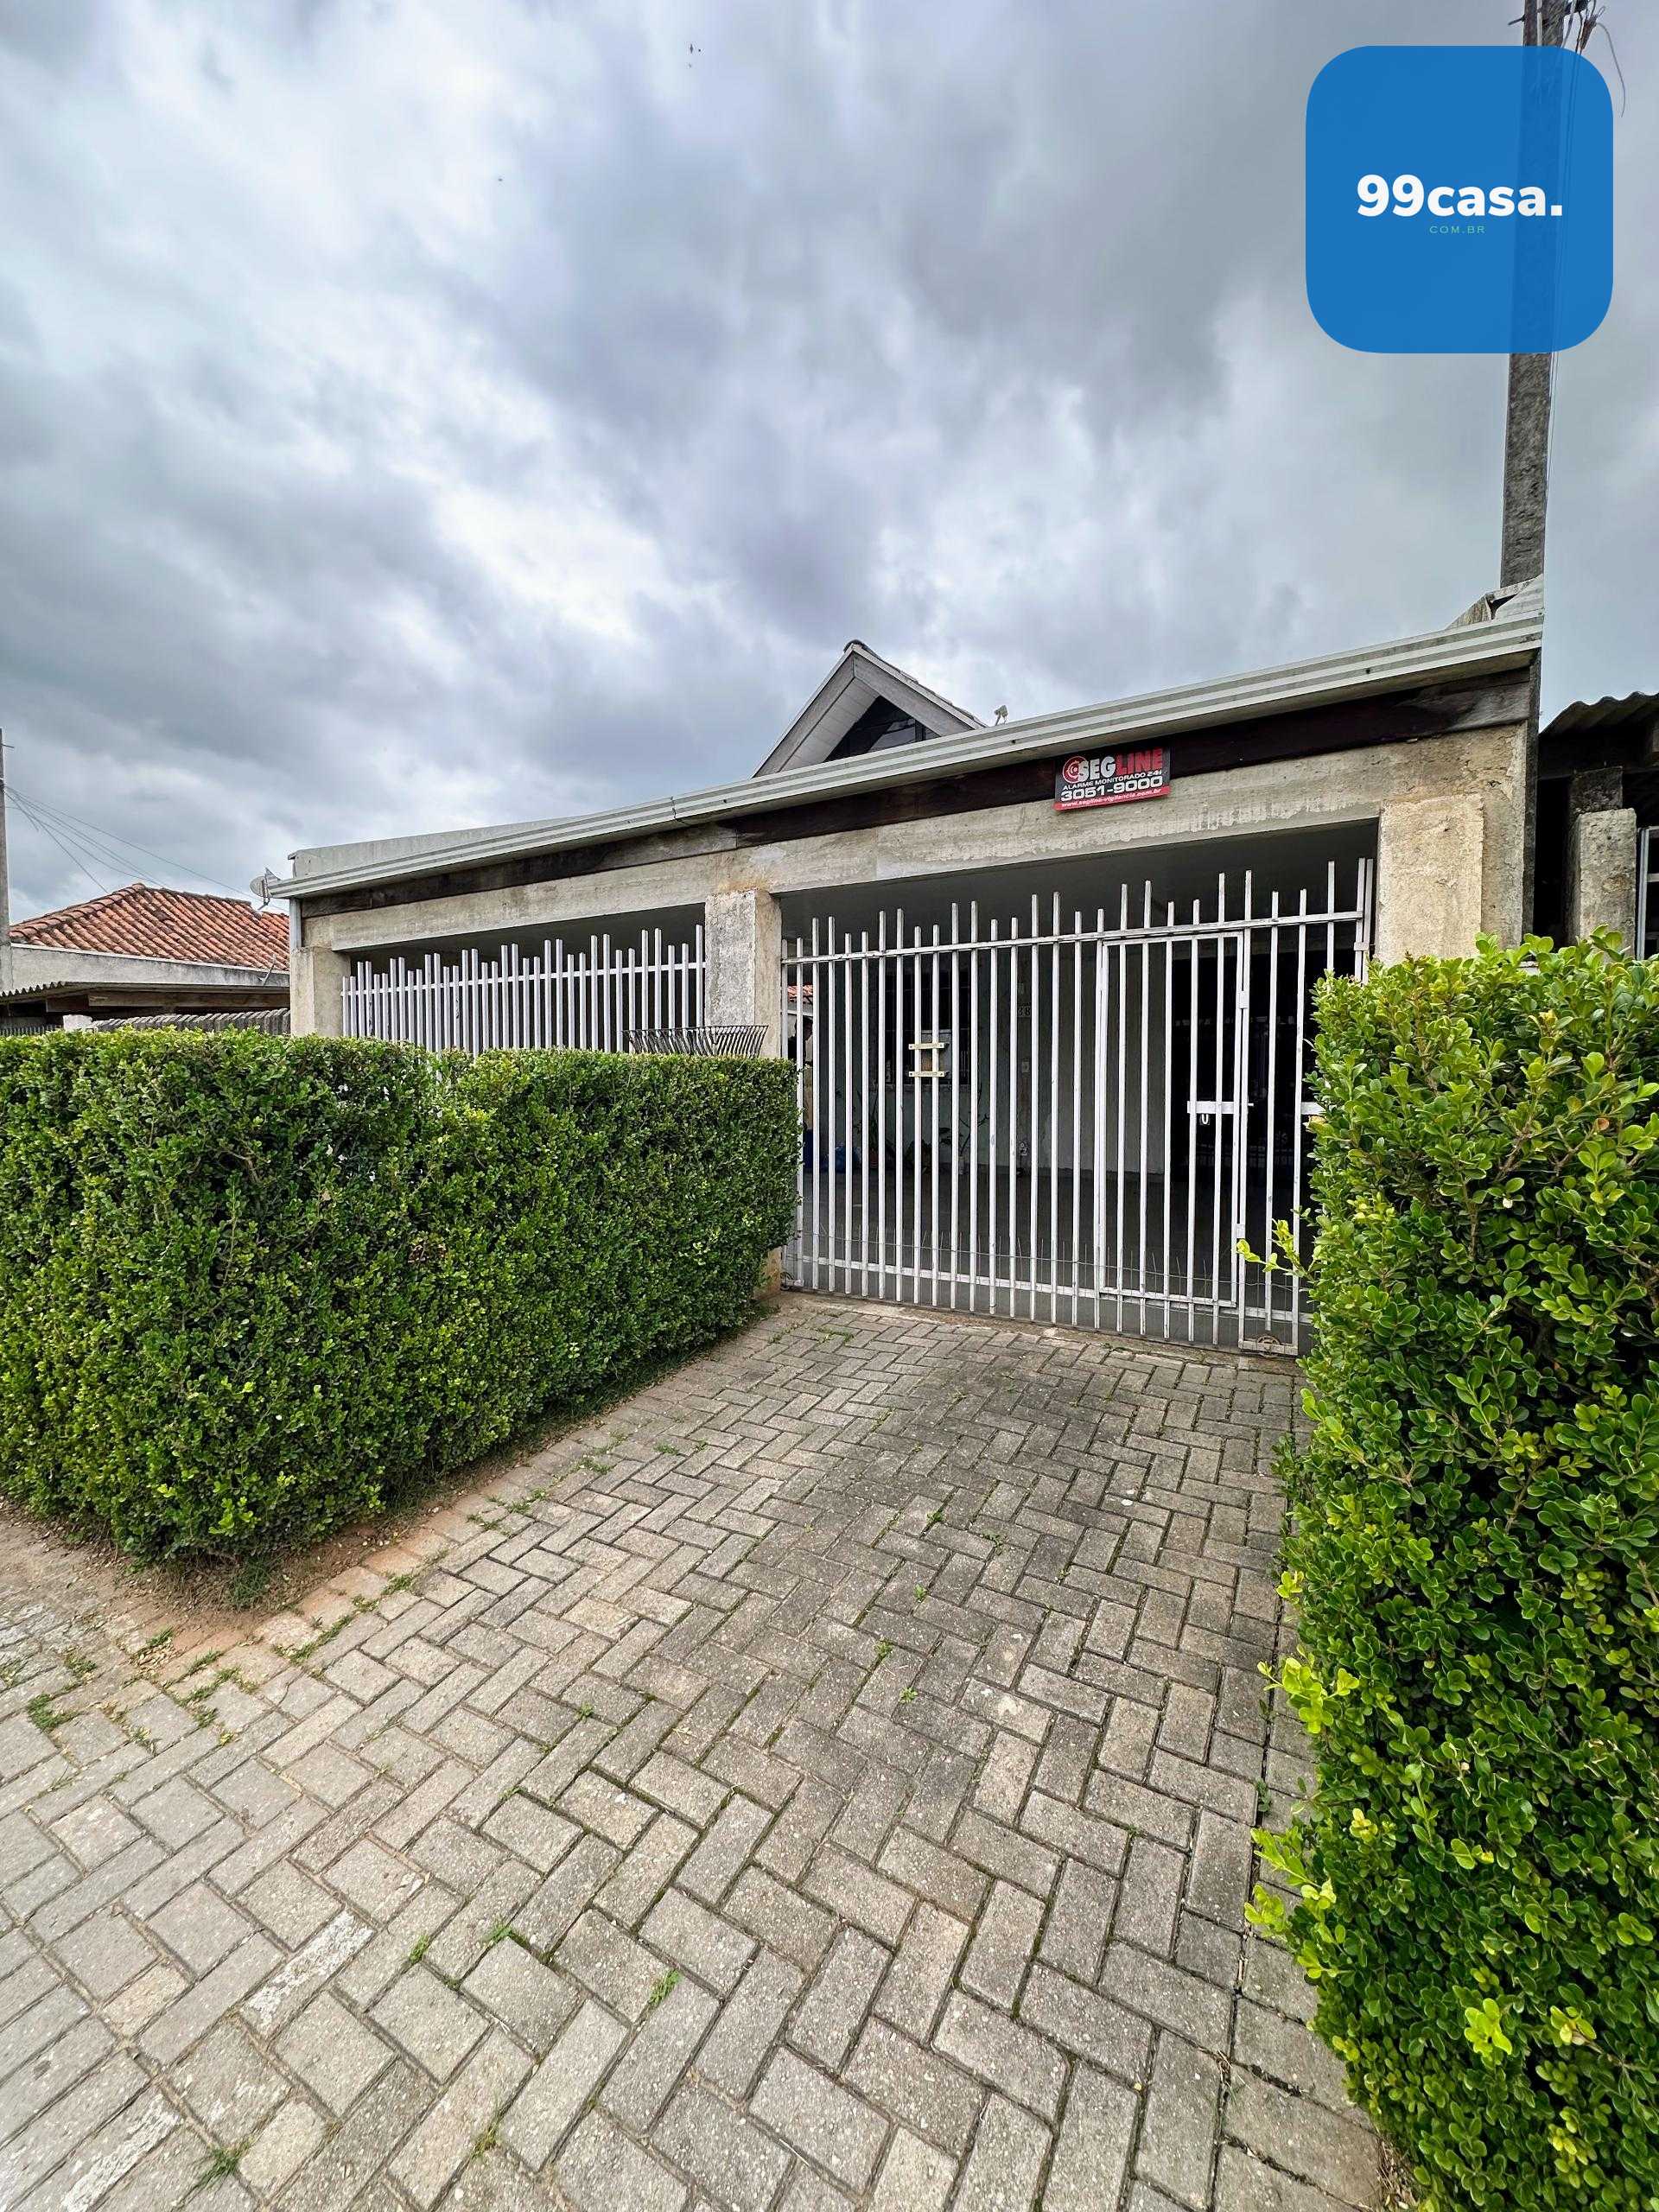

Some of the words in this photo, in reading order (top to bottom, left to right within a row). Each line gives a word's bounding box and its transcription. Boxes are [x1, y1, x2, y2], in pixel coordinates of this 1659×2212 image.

[1060, 775, 1163, 802] 3051-9000
[1063, 780, 1094, 791] ALARME
[1095, 772, 1146, 785] MONITORADO
